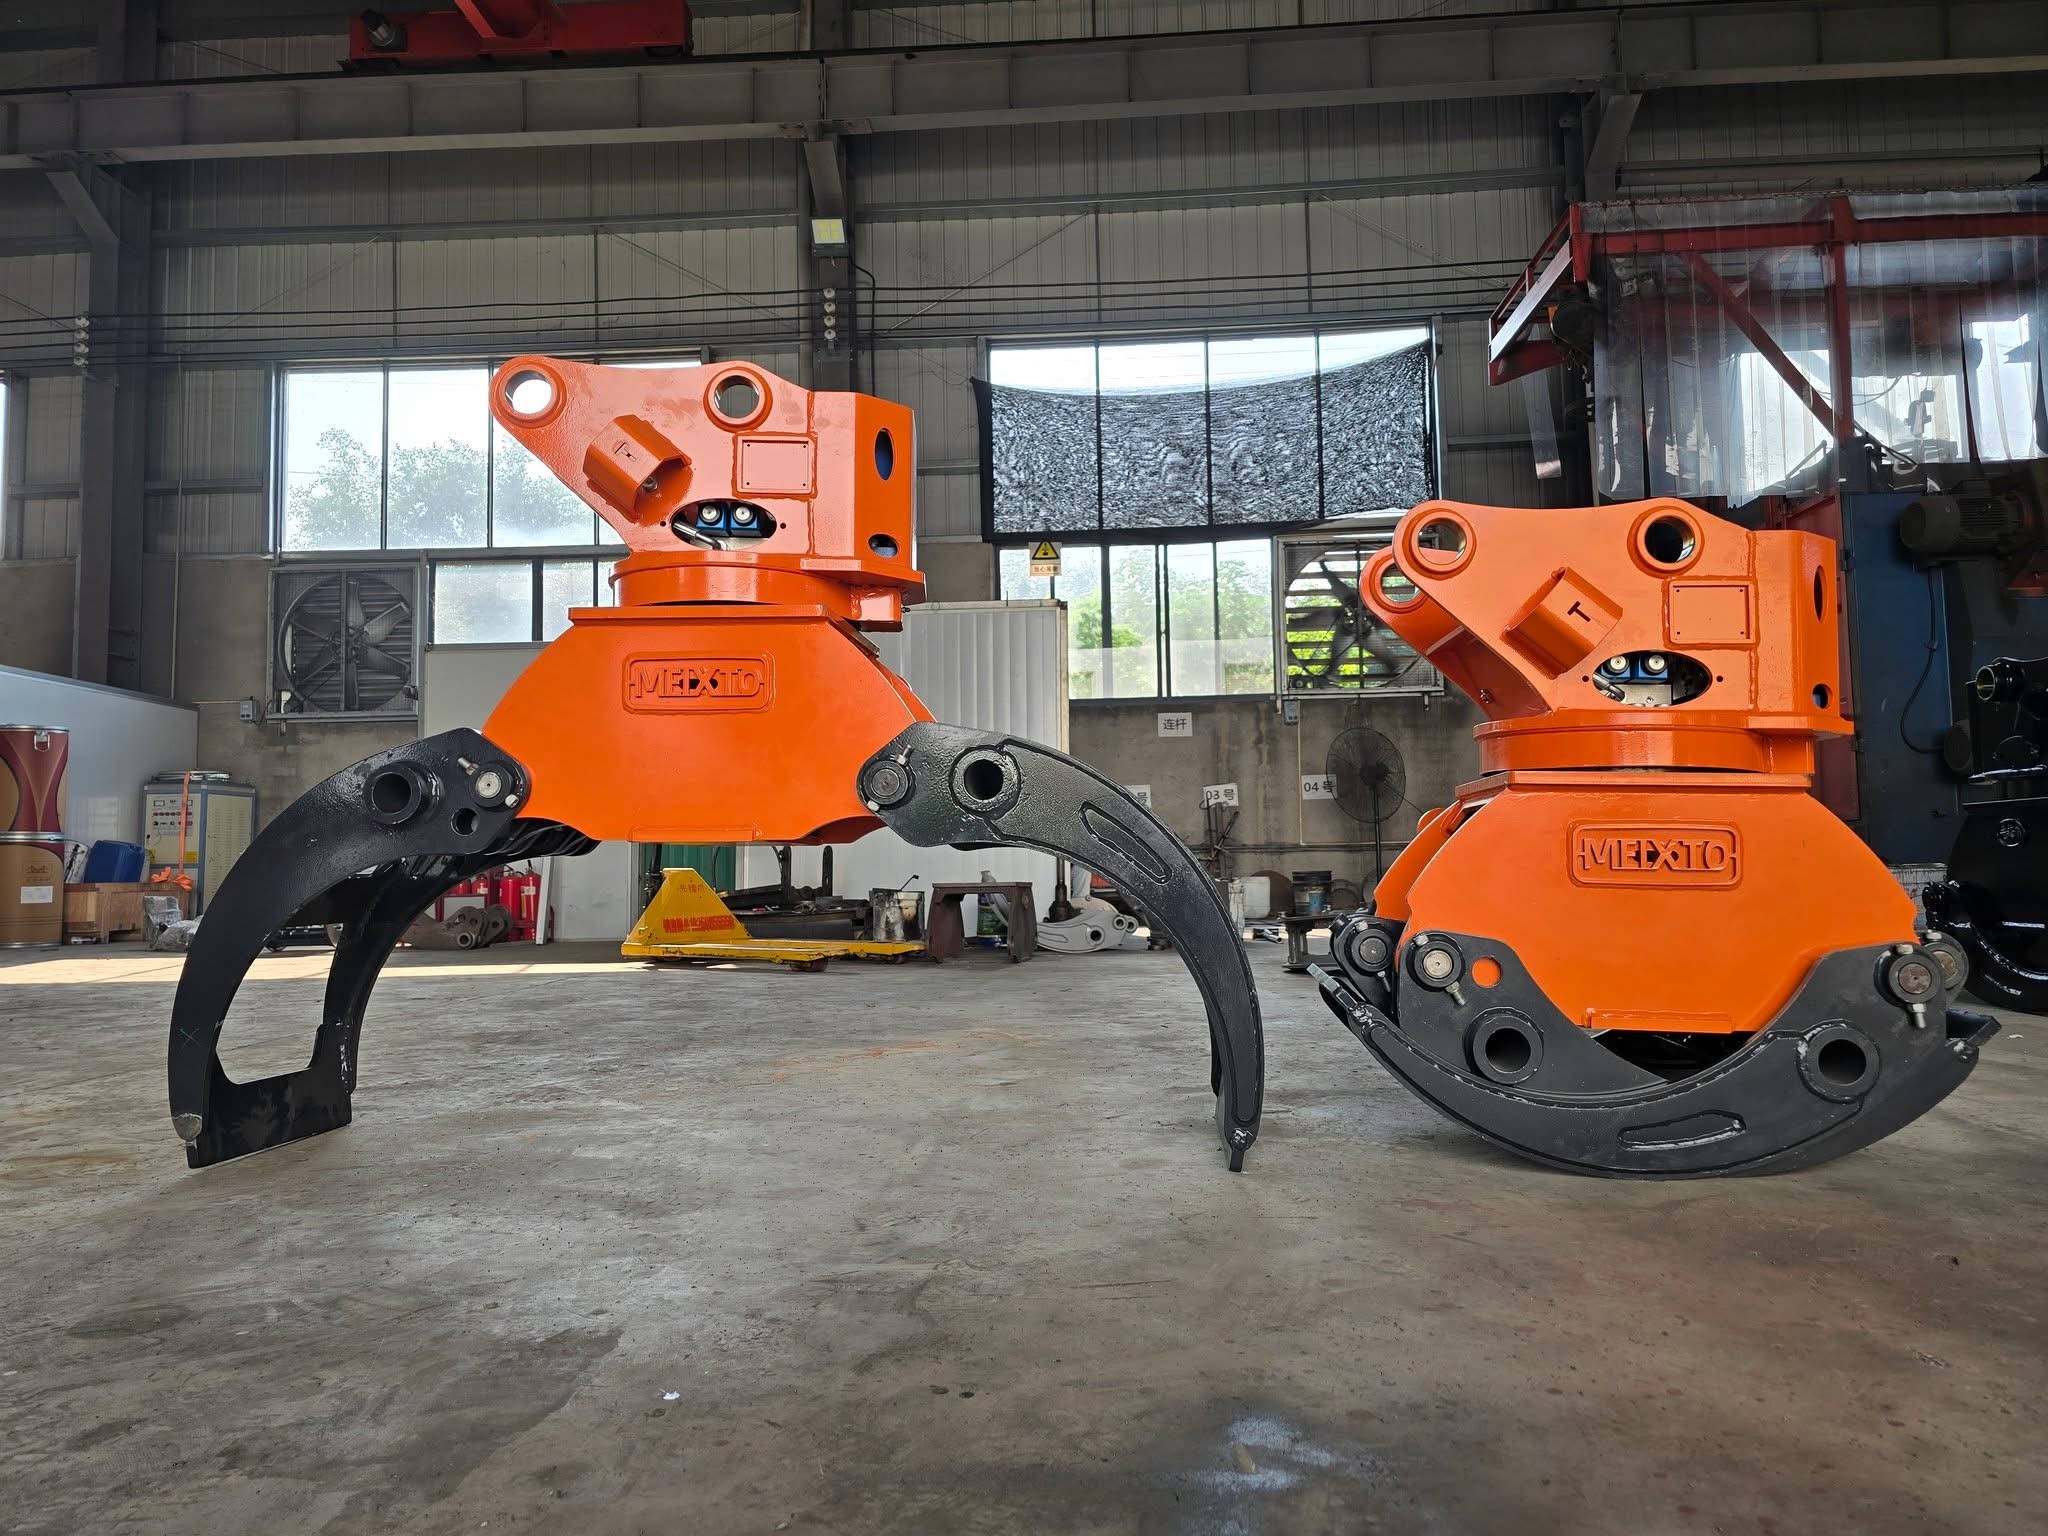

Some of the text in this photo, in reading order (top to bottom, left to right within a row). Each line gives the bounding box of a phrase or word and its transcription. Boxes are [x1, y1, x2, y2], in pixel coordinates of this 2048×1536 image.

[1567, 600, 1591, 622] T
[634, 668, 762, 698] MEIXTO
[1163, 718, 1188, 730] 连杆
[1205, 788, 1236, 801] 03 号
[1303, 780, 1336, 793] 04 号
[1583, 838, 1728, 871] MEIXTO
